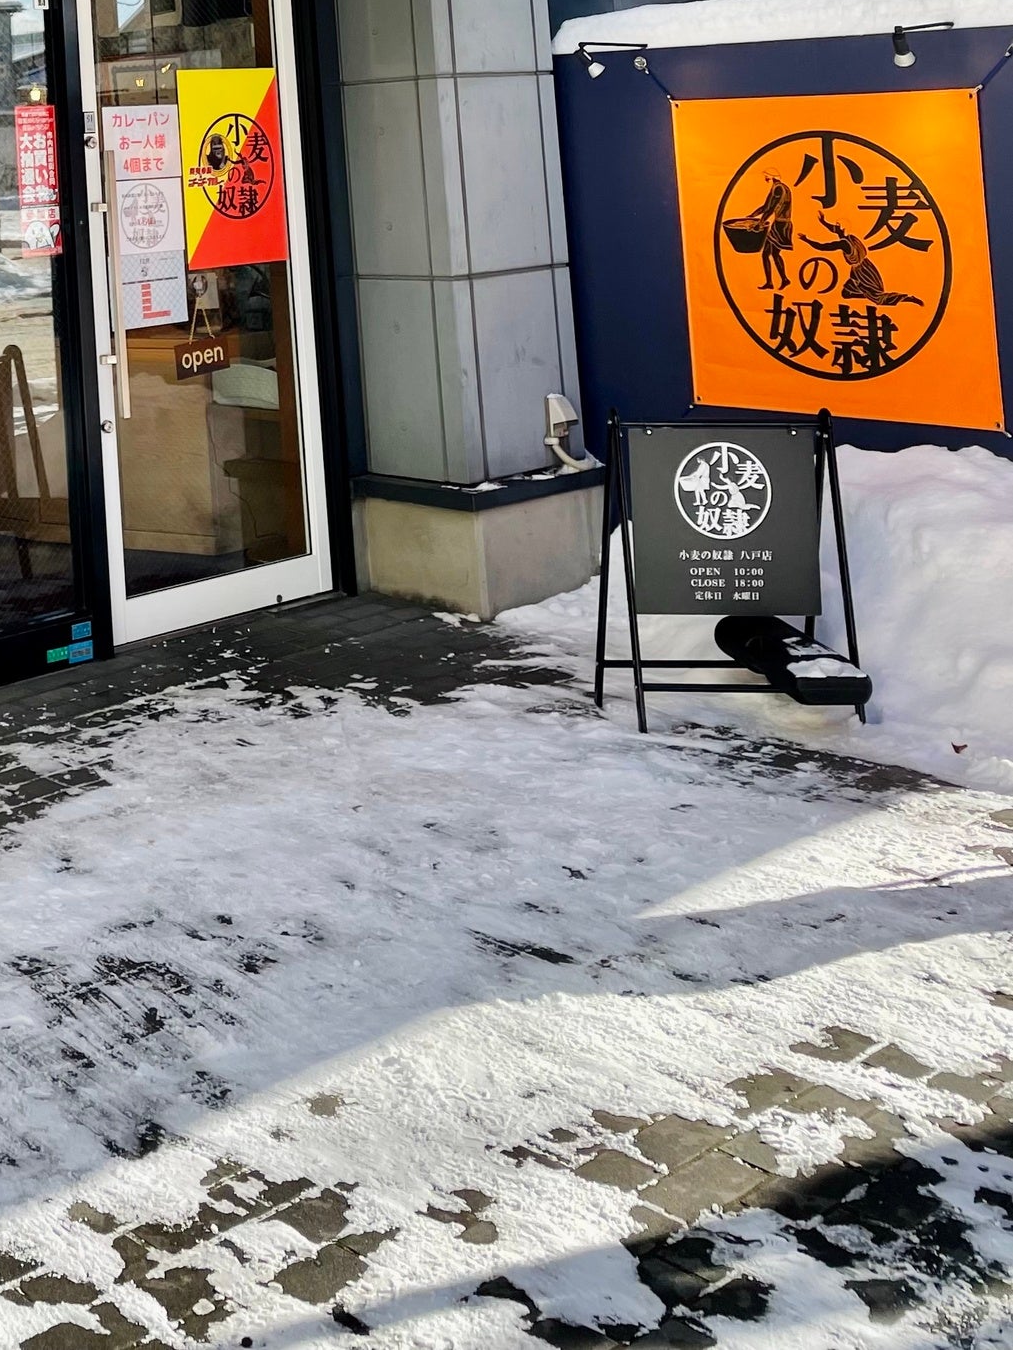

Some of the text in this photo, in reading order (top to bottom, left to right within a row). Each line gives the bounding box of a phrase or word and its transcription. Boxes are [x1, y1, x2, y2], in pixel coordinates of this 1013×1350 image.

[112, 112, 170, 128] カレーパン
[119, 134, 166, 151] お一人様
[123, 156, 164, 173] 4個まで
[182, 346, 224, 373] open
[679, 550, 773, 561] 小麦の奴隷 八戸店
[690, 567, 764, 576] OPEN 10:00
[691, 579, 764, 587] CLOSE 18:00
[694, 591, 760, 601] 定休日 水曜日
